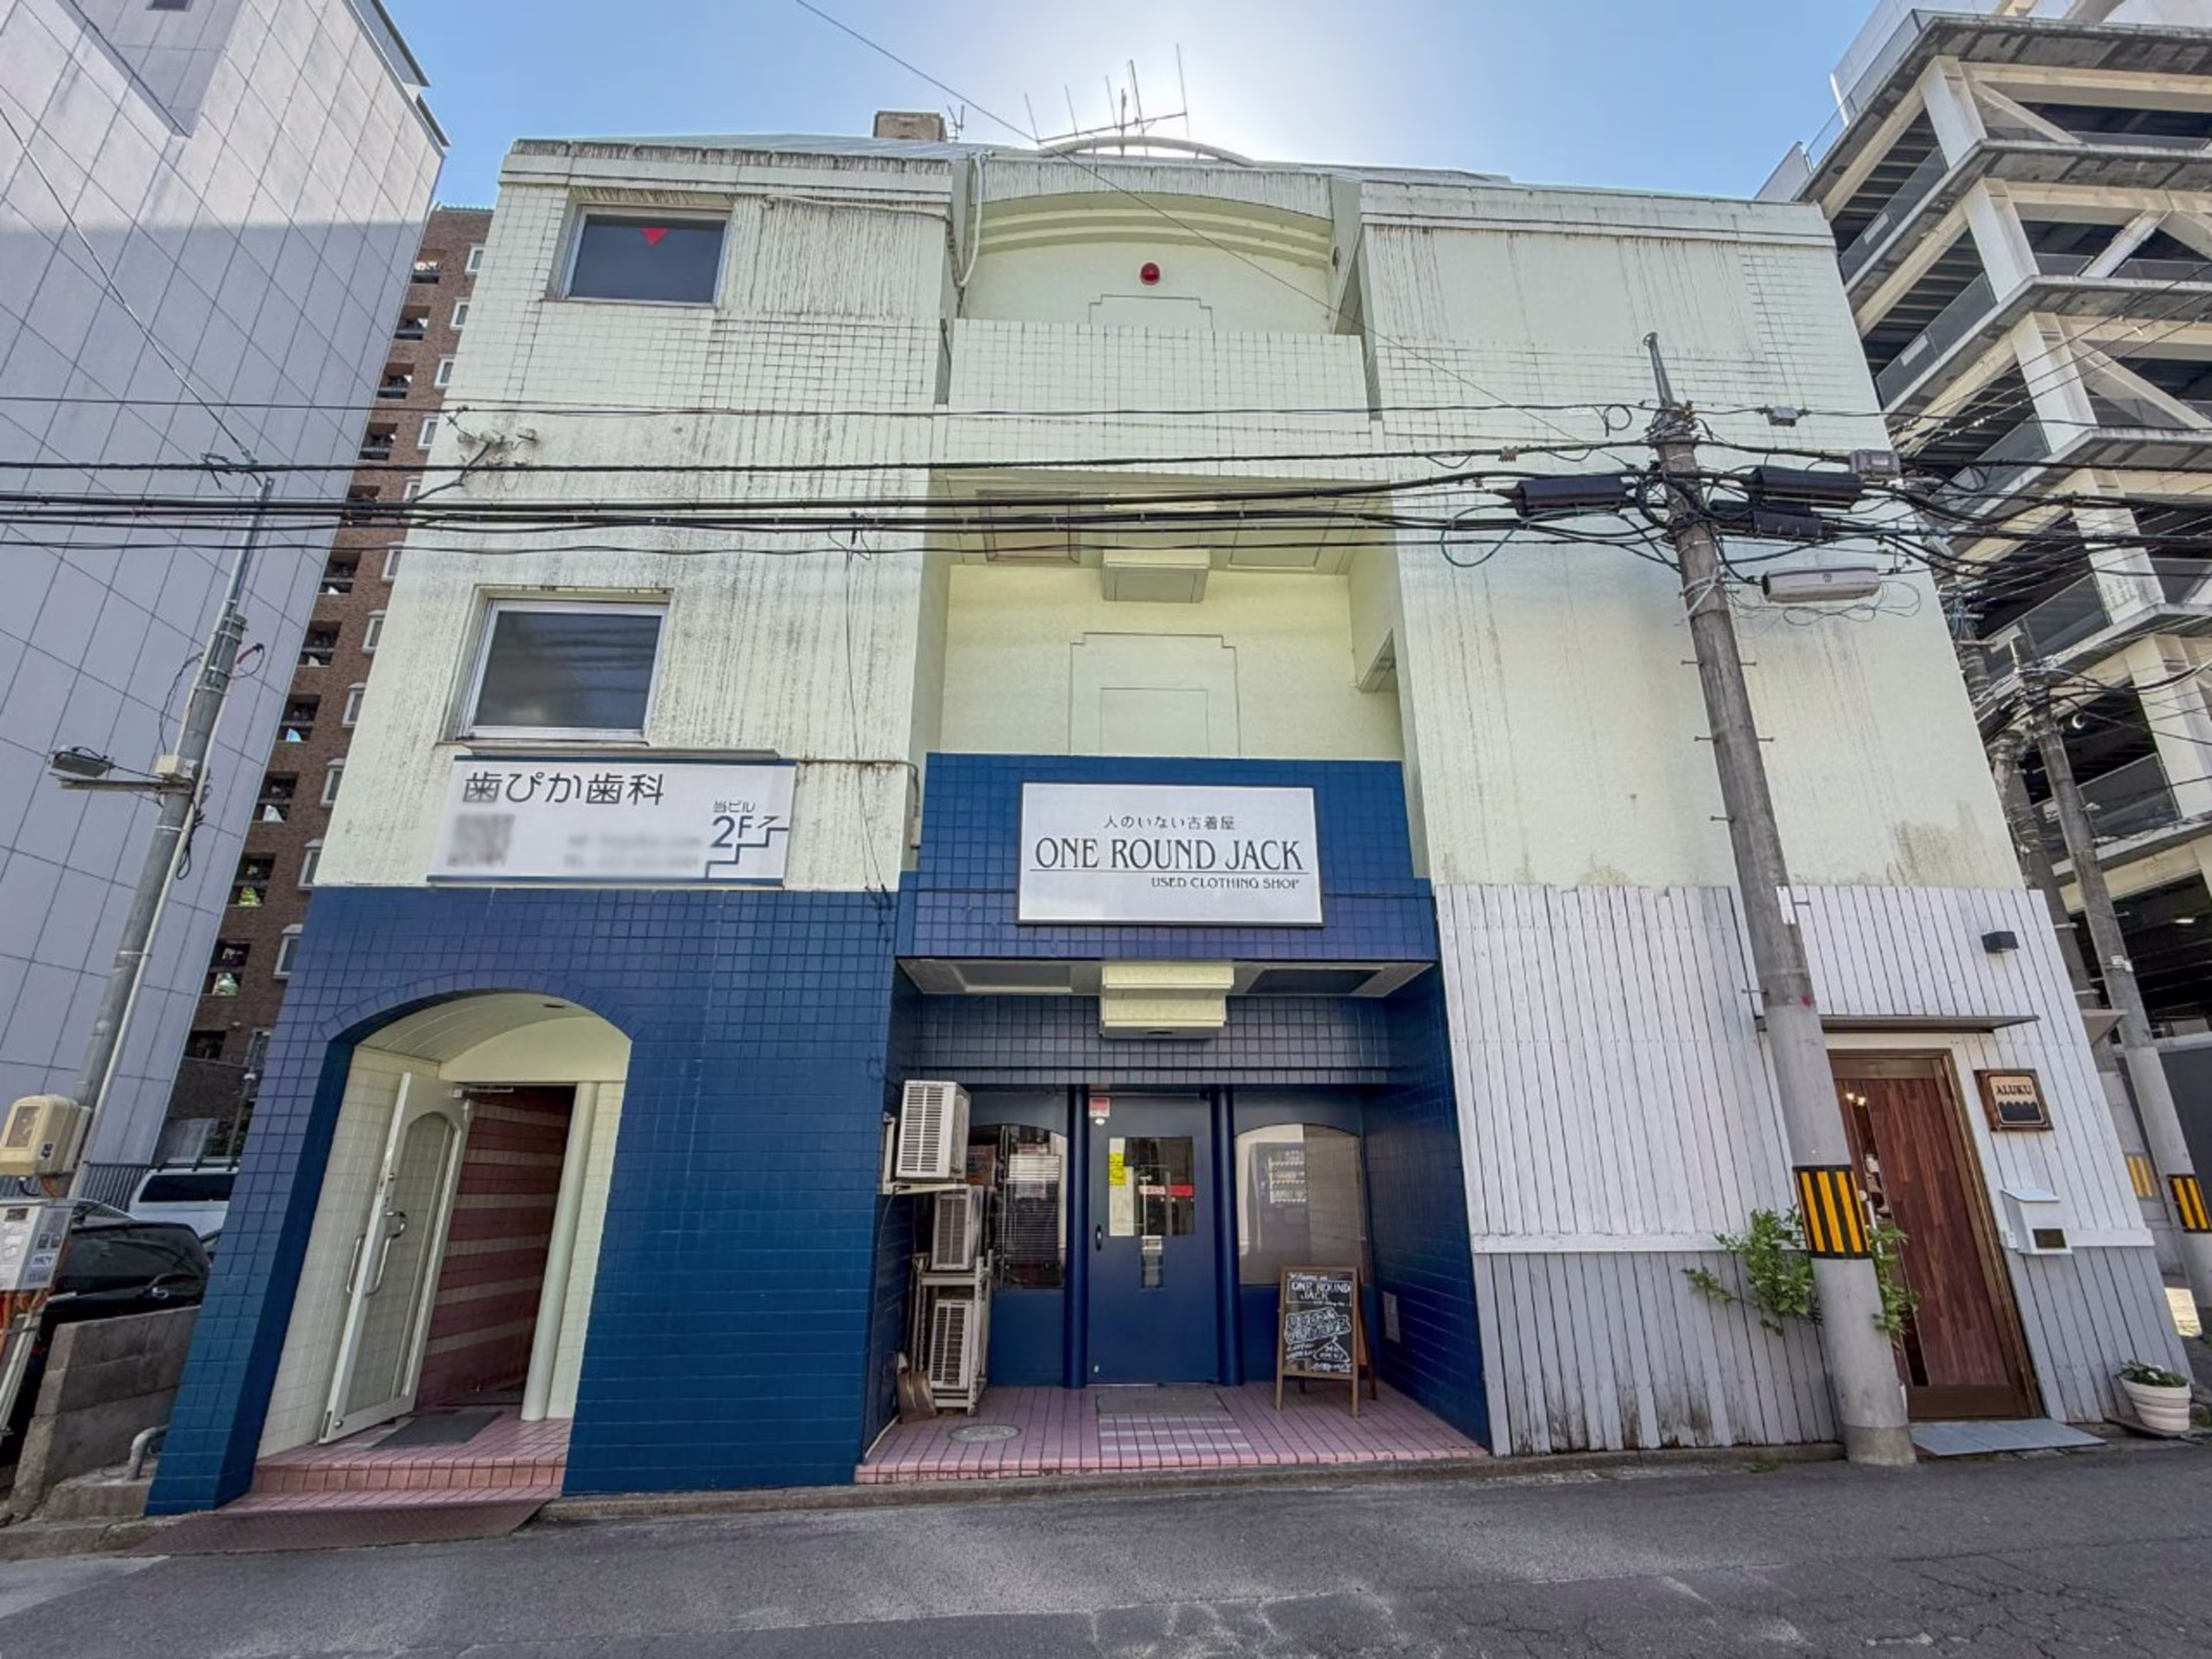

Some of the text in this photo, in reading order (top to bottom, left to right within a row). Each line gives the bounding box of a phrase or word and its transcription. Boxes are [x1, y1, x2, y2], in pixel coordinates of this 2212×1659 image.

[463, 771, 664, 805] 歯ぴか歯科
[713, 800, 755, 813] 当ビル
[1104, 815, 1235, 830] 人のいない古着屋
[710, 815, 753, 848] 2F
[1035, 837, 1303, 870] ONE ROUND JACK
[1151, 877, 1300, 889] USED CLOTHING SHOP
[1995, 1085, 2032, 1095] ALUKU
